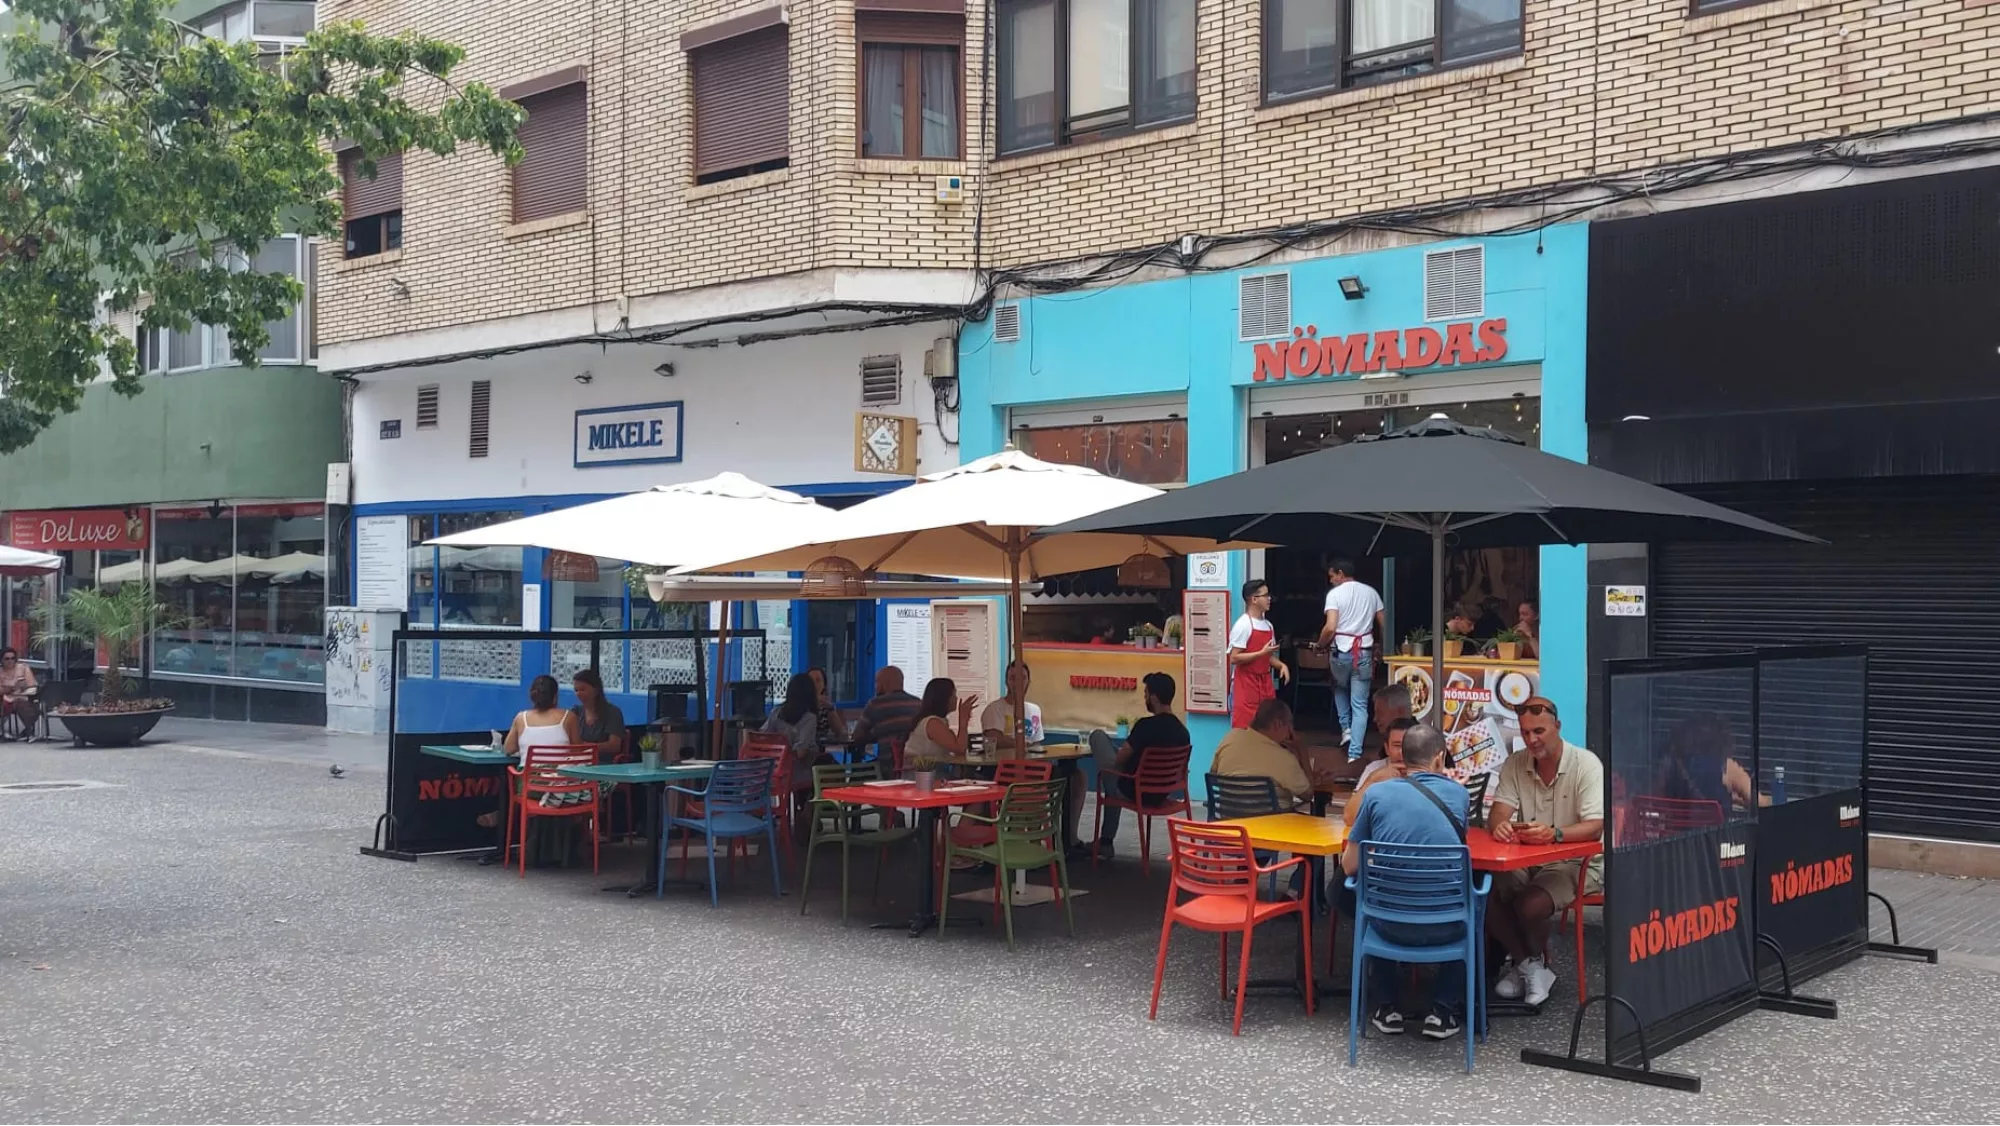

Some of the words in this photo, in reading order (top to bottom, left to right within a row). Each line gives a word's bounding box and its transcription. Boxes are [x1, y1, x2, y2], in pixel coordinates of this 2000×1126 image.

[1254, 319, 1507, 383] NÖMADAS
[588, 418, 664, 451] MIKELE
[40, 517, 121, 543] DeLuxe
[1443, 689, 1491, 701] NÖMADAS
[1770, 854, 1853, 905] NÖMADAS
[1629, 897, 1739, 963] NÖMADAS
